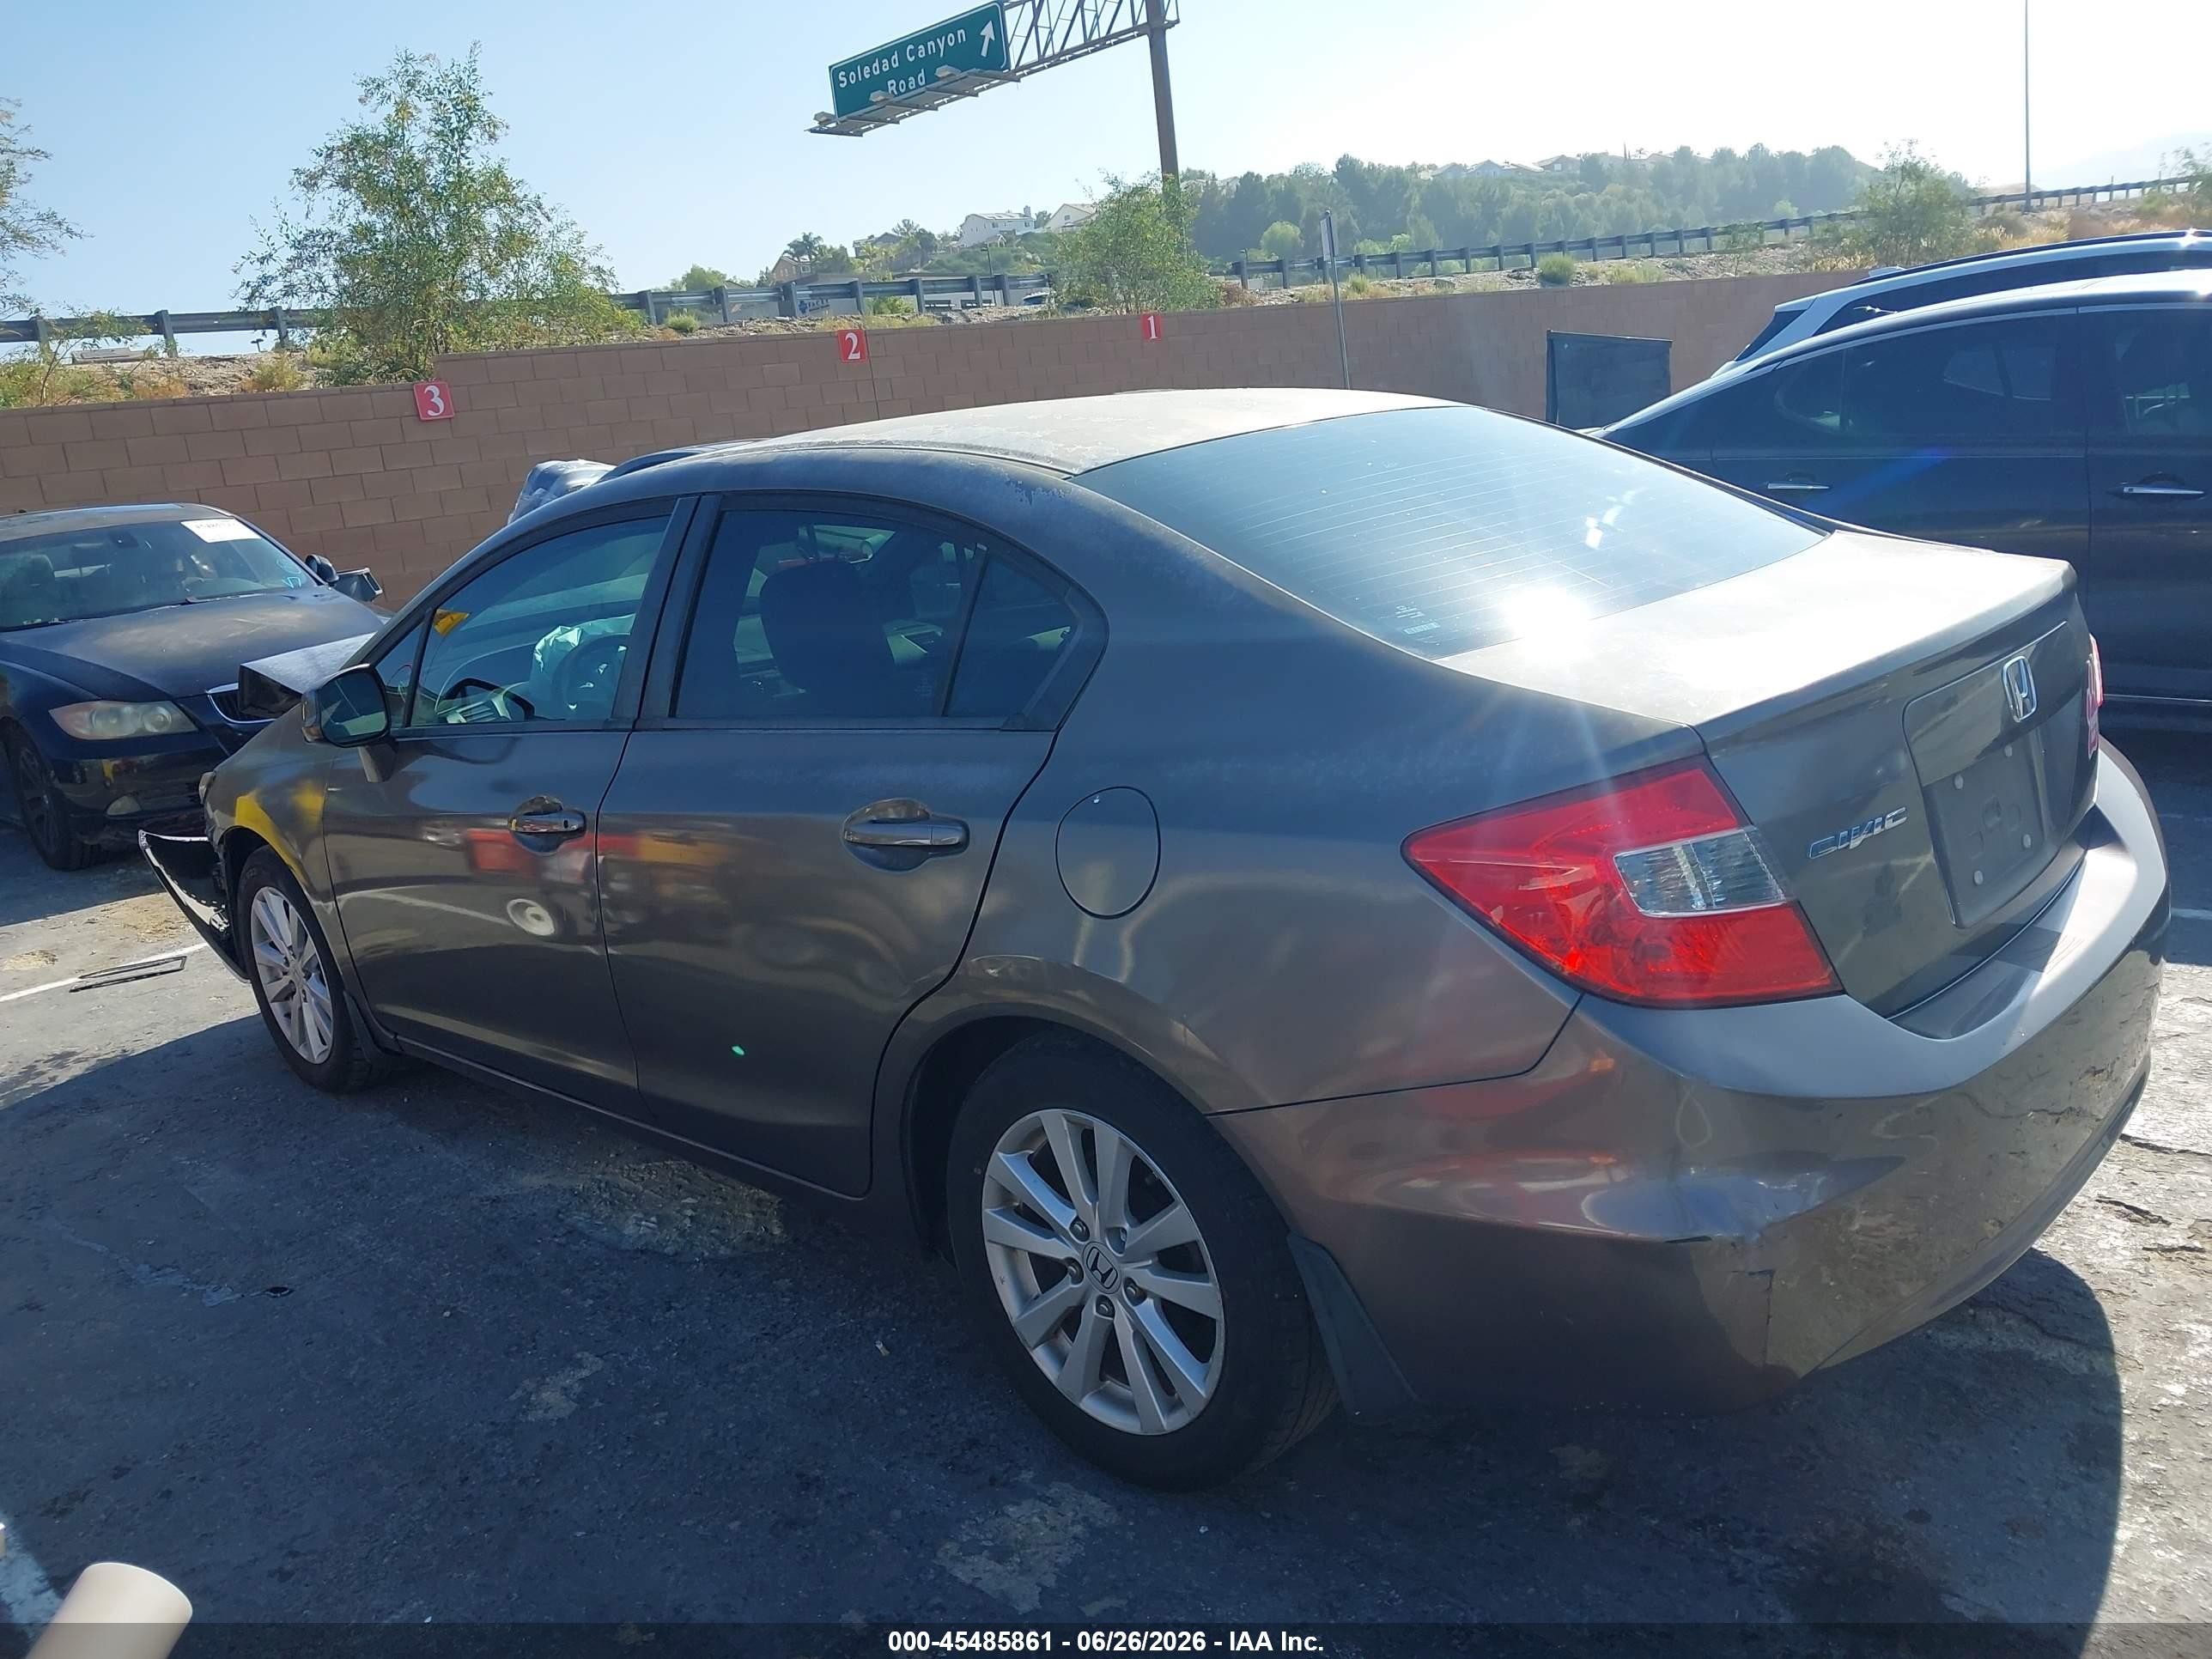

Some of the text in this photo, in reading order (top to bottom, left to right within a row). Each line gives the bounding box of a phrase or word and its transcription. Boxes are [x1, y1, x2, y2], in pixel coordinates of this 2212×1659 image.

[838, 28, 966, 88] Soledad Canyon
[887, 68, 926, 95] Road
[1147, 315, 1158, 339] 1
[845, 332, 860, 360] 2
[424, 385, 445, 416] 3
